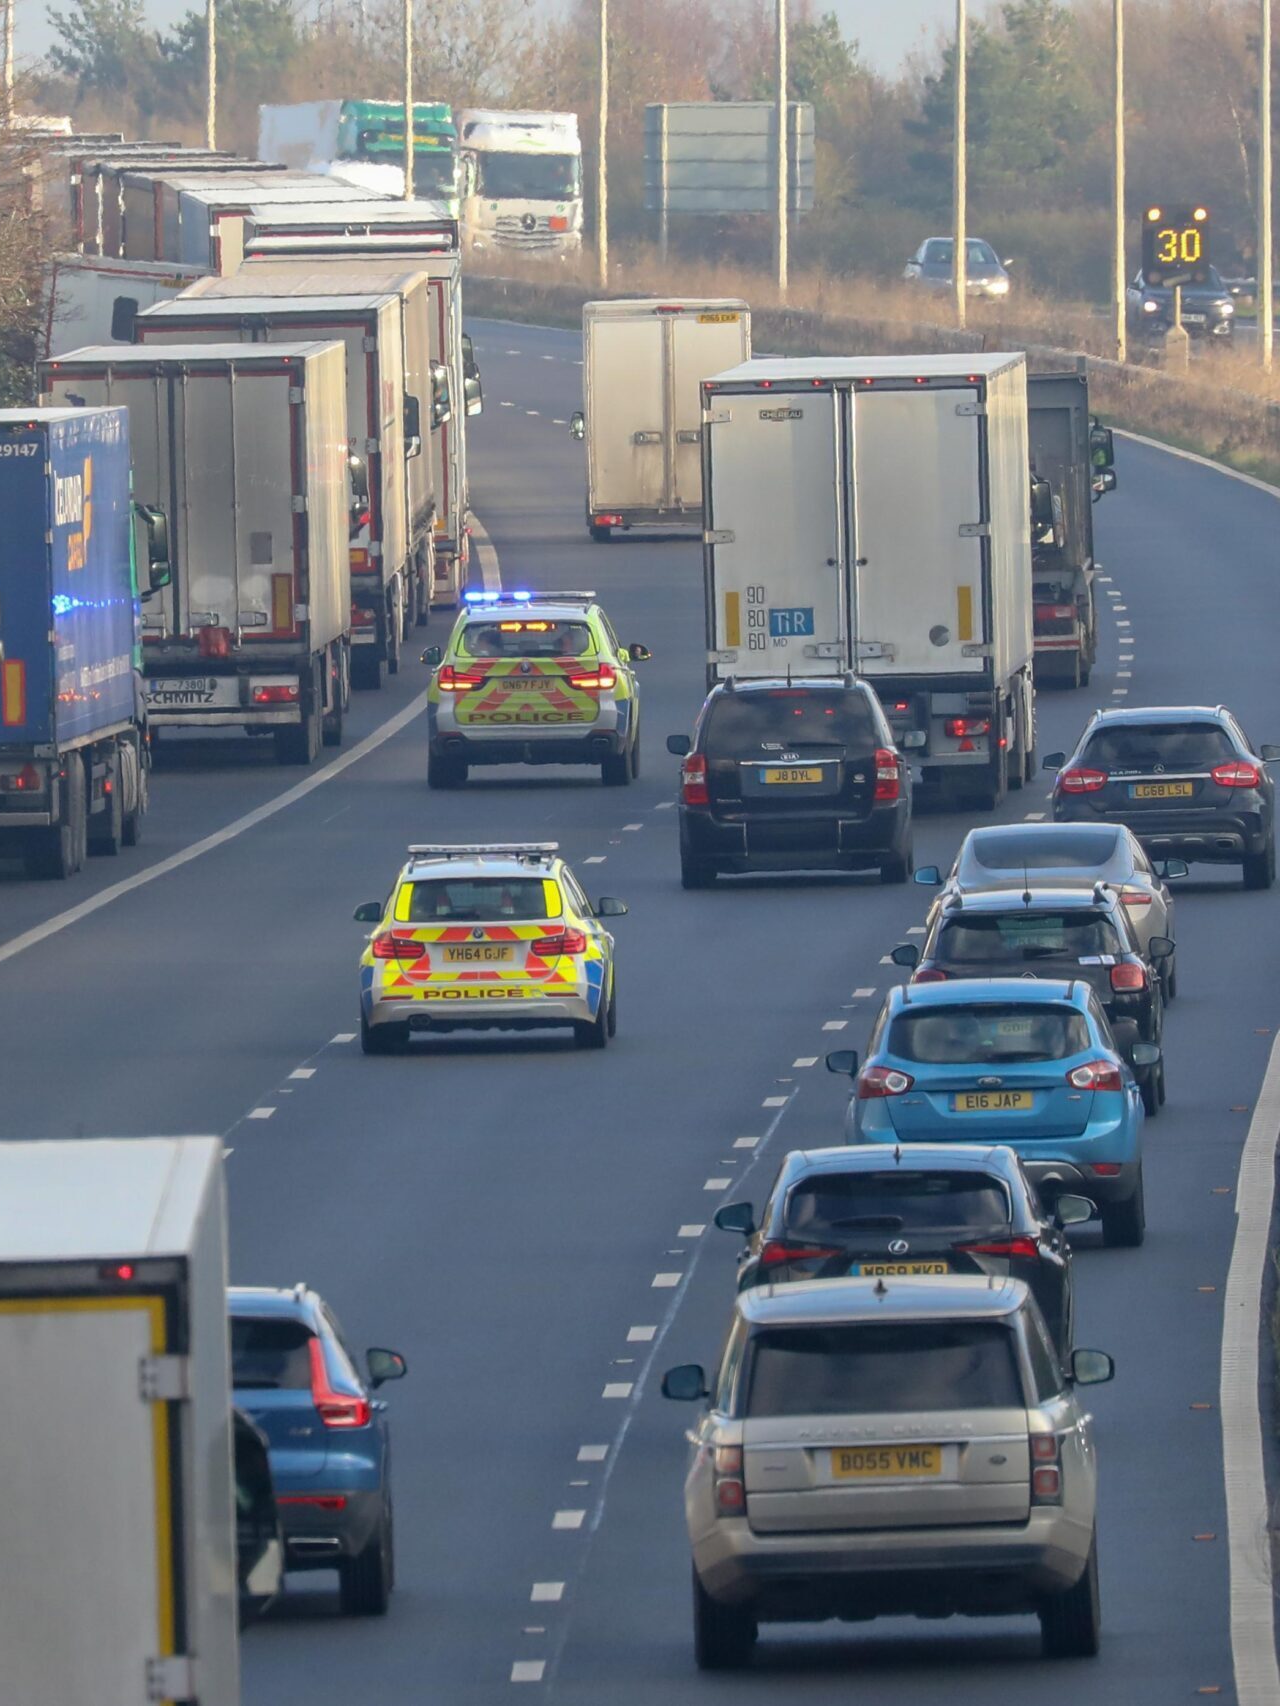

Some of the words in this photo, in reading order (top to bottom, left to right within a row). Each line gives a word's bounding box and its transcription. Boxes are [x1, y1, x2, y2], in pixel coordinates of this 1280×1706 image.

[1158, 229, 1200, 262] 30
[747, 586, 764, 604] 90
[748, 609, 765, 628] 80
[749, 633, 766, 650] 60
[469, 712, 585, 723] POLICE
[448, 948, 480, 960] YH64
[485, 947, 508, 959] GJF
[423, 989, 524, 999] POLICE
[966, 1094, 988, 1108] E16
[994, 1093, 1022, 1107] JAP
[841, 1453, 890, 1472] BO55
[896, 1451, 933, 1468] VMC
